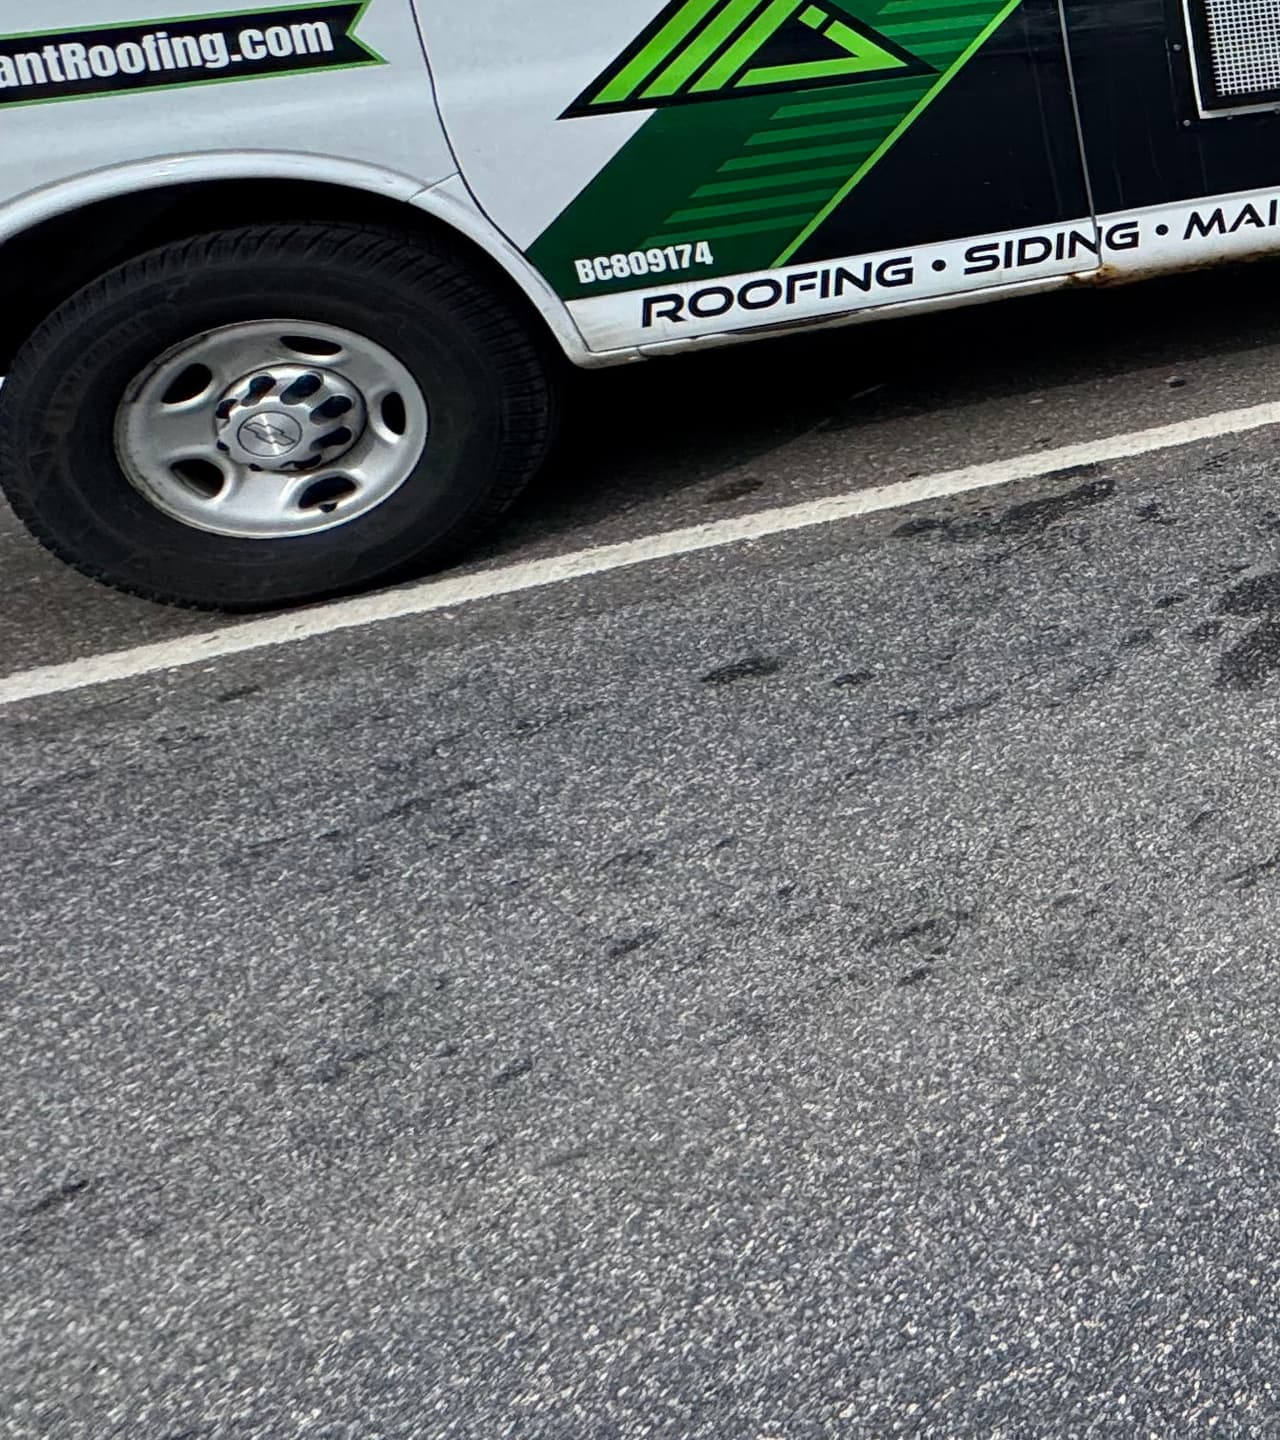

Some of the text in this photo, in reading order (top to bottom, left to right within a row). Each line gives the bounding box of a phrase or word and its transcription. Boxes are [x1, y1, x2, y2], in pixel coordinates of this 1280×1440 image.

[574, 240, 714, 285] BC809174
[641, 256, 915, 328] ROOFING
[963, 220, 1141, 275] SIDING
